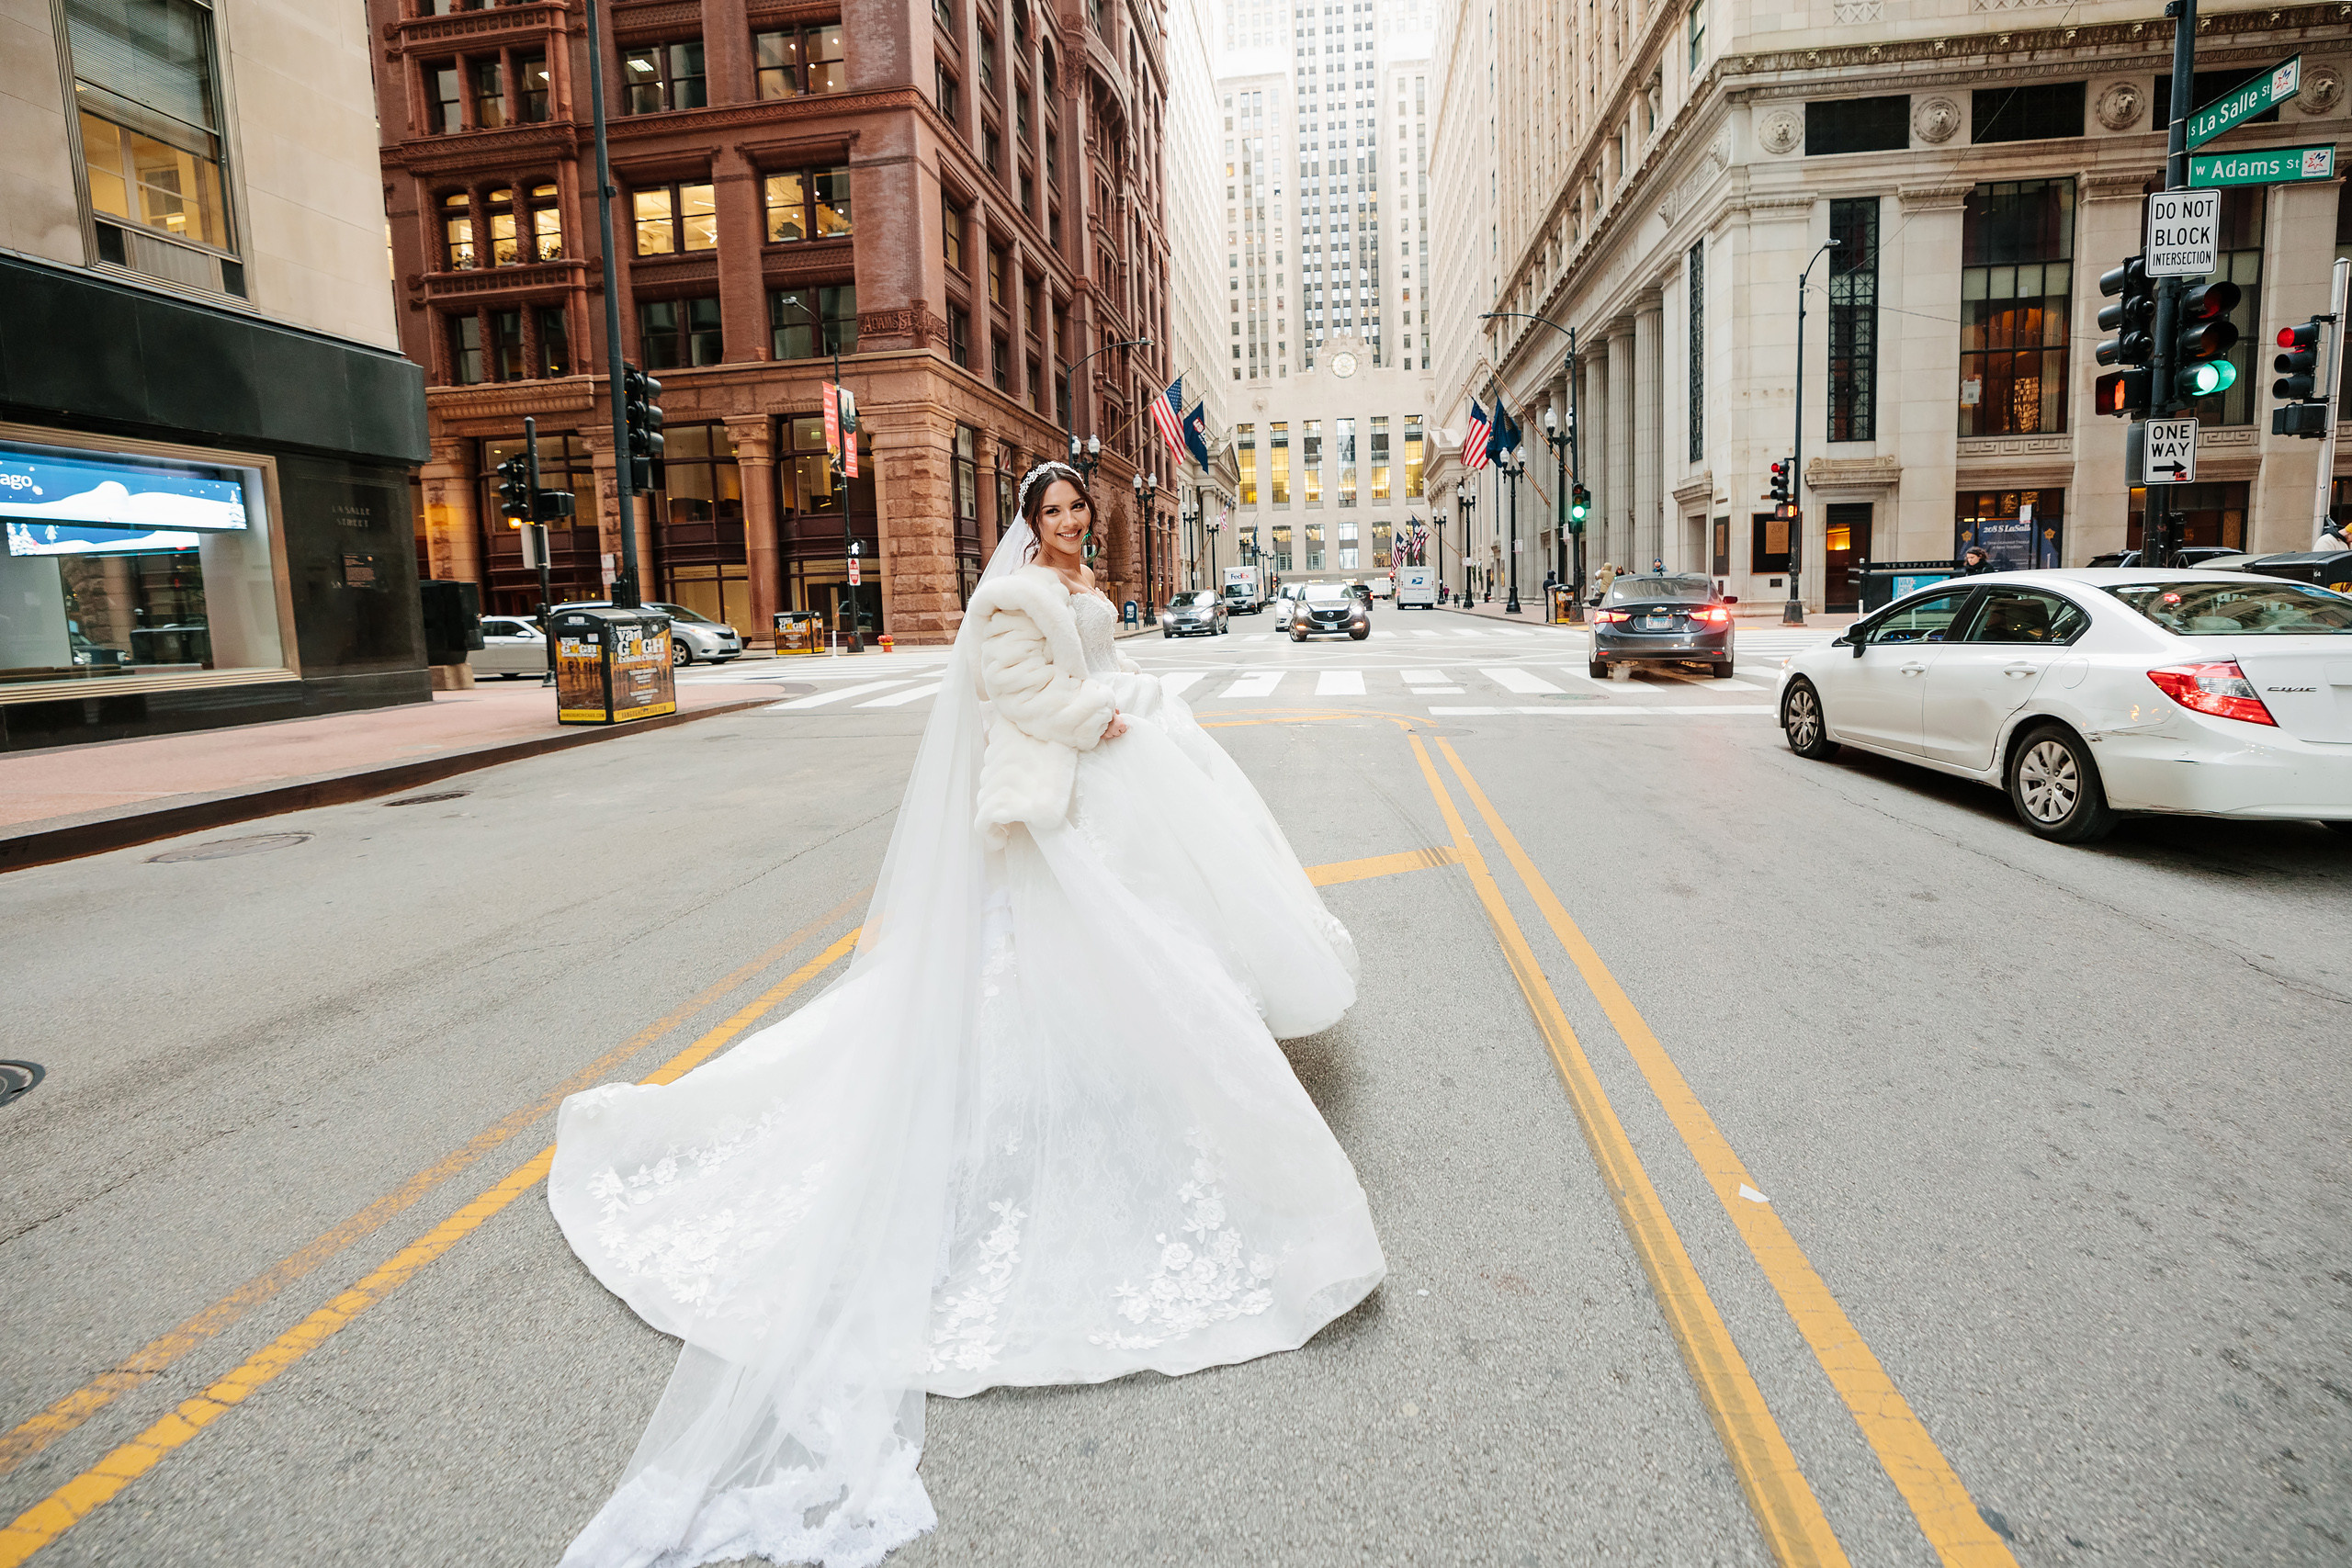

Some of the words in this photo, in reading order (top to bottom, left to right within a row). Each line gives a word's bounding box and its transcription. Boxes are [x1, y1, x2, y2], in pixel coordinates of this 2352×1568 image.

[2190, 125, 2196, 137] S
[2199, 115, 2216, 136] La
[2219, 90, 2257, 125] Salle
[2261, 83, 2271, 97] St
[2211, 159, 2280, 179] Adams
[2286, 159, 2300, 170] St
[2154, 203, 2177, 220] DO
[2182, 199, 2214, 219] NOT
[2154, 227, 2211, 246] BLOCK
[2153, 250, 2211, 266] INTERSECTION
[2153, 424, 2190, 440] ONE
[2152, 442, 2190, 457] WAY
[0, 473, 33, 491] ago
[336, 518, 368, 527] STREET
[1983, 525, 1997, 534] 208
[1884, 561, 1951, 570] NEWSPAPERS
[616, 630, 643, 642] van
